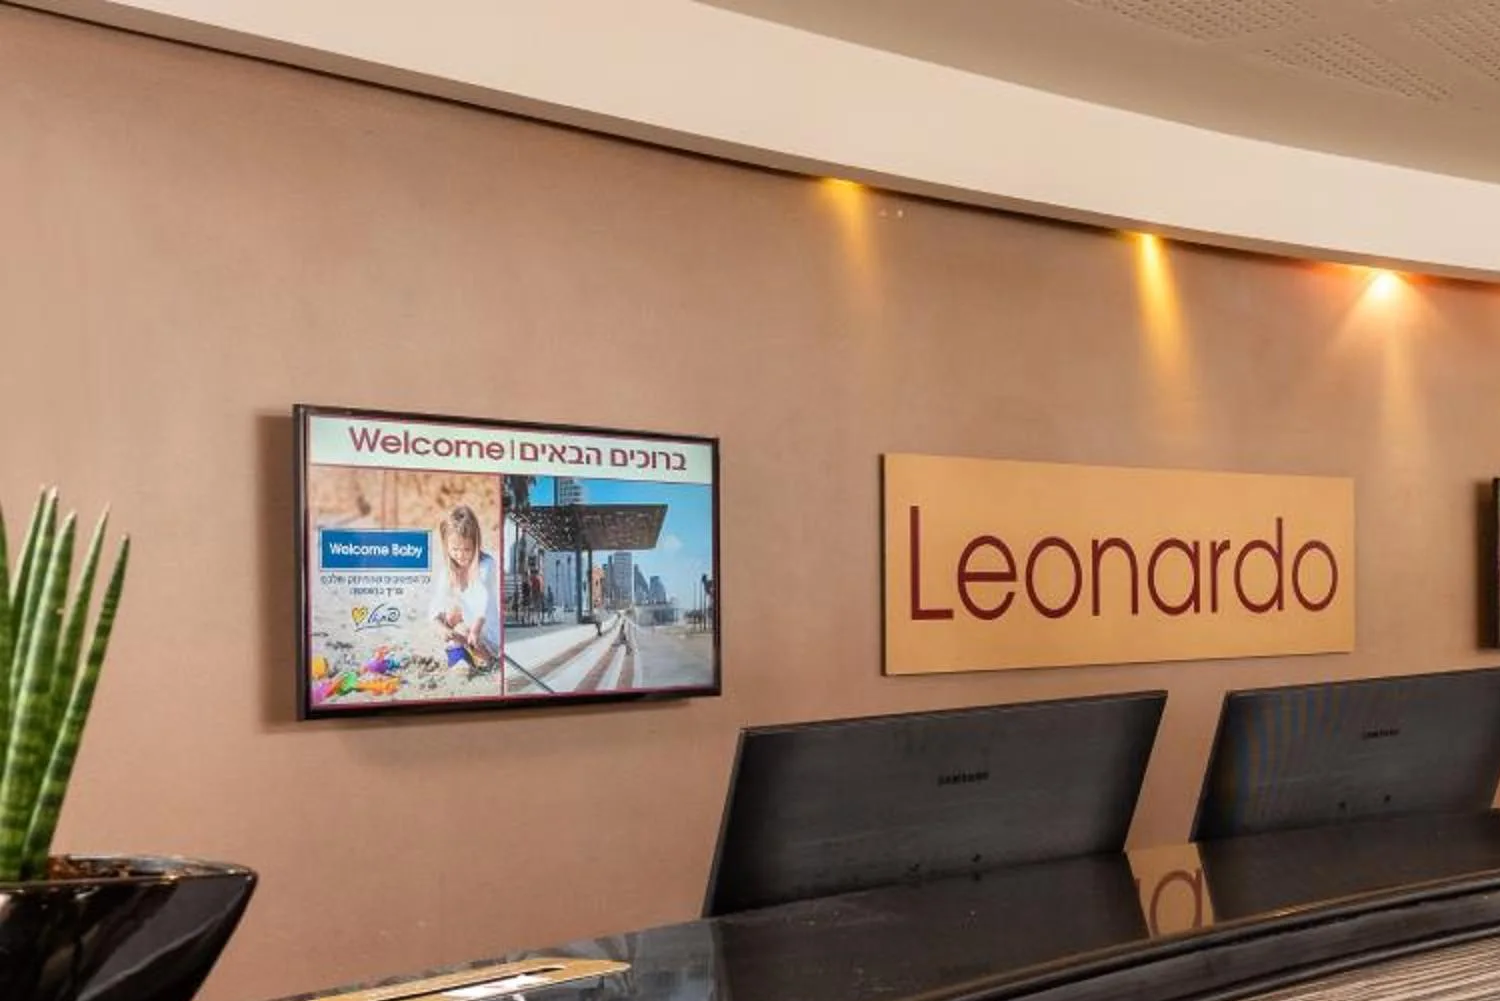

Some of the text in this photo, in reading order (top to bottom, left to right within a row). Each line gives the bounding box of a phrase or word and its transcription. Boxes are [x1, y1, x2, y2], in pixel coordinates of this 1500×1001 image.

[348, 426, 506, 461] Welcome
[519, 441, 688, 471] ברוכים הבאים
[329, 541, 423, 559] Welcome Baby
[909, 505, 1339, 621] Leonardo
